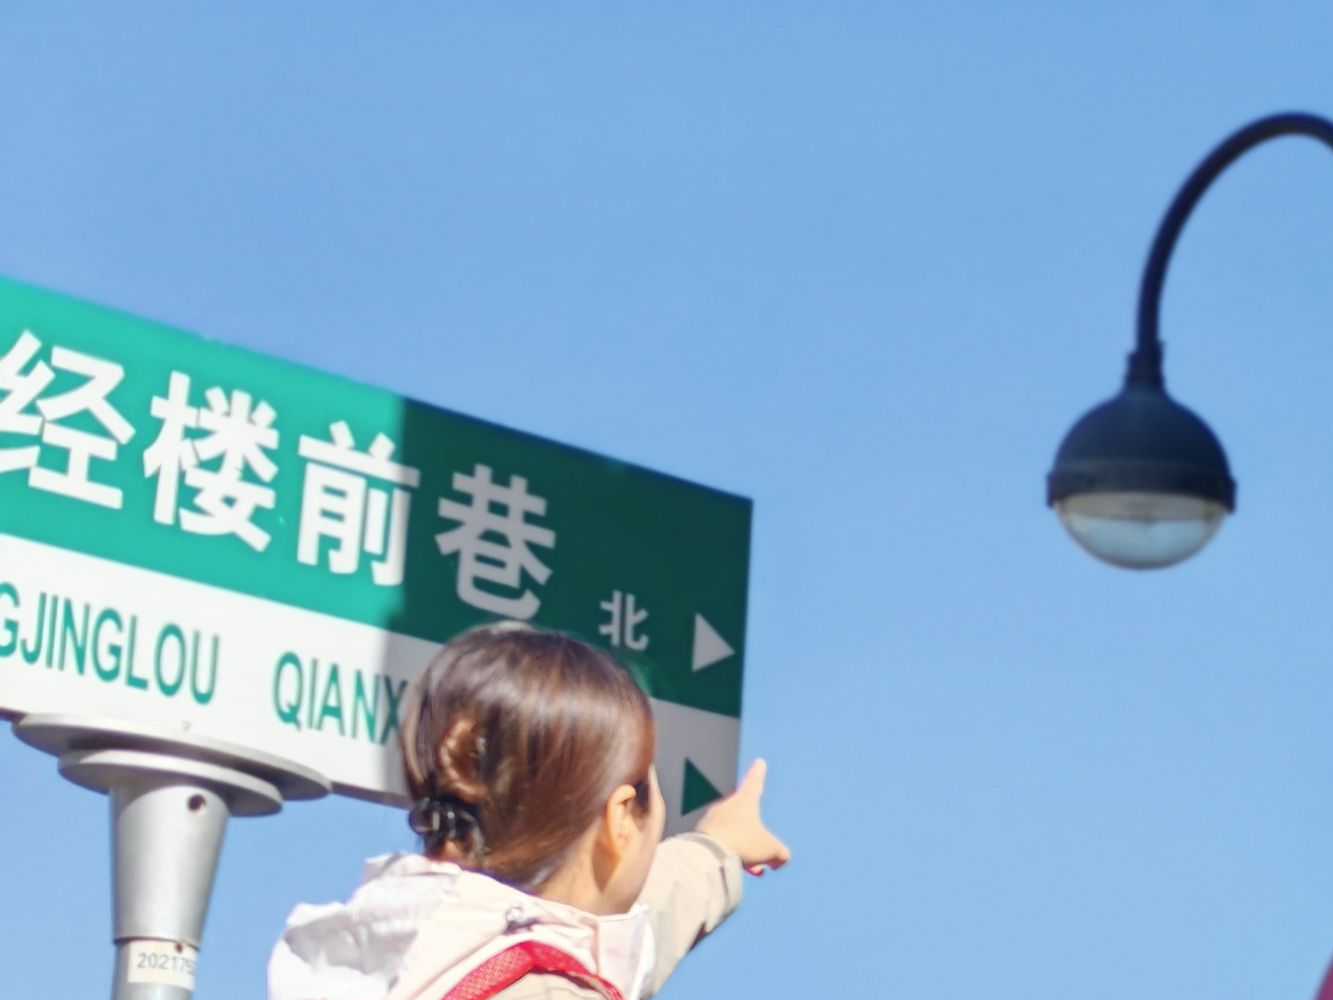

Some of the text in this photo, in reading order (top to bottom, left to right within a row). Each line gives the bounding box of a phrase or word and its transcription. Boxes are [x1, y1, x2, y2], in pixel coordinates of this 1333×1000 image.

[0, 330, 557, 621] 经楼前巷
[599, 590, 649, 651] 北
